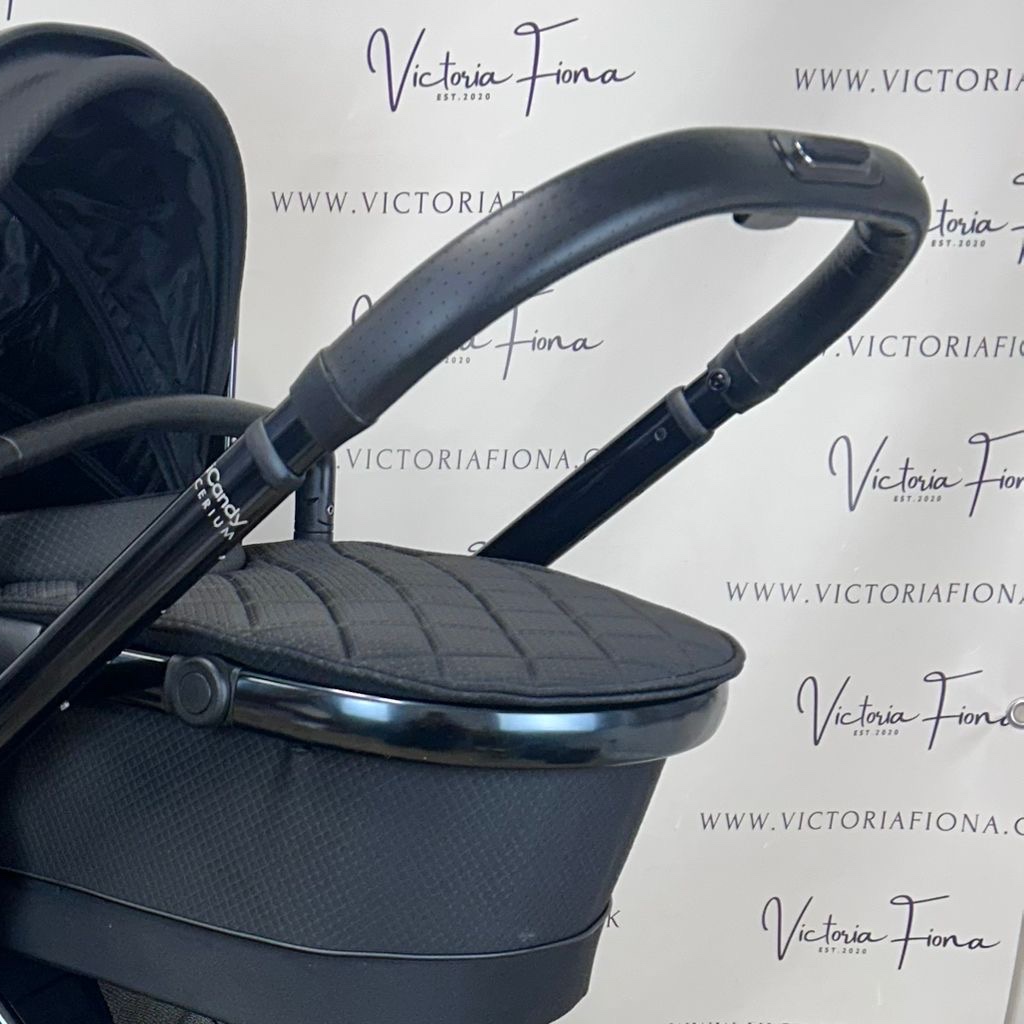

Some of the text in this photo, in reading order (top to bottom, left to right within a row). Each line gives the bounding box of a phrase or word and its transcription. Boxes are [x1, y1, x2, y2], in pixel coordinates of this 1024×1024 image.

[366, 18, 636, 117] Victoria Fiona
[436, 93, 491, 101] EST.2020
[194, 477, 235, 540] CERIUM
[828, 434, 963, 513] Victoria
[797, 675, 921, 746] Victoria
[761, 894, 1000, 970] Victoria Fiona
